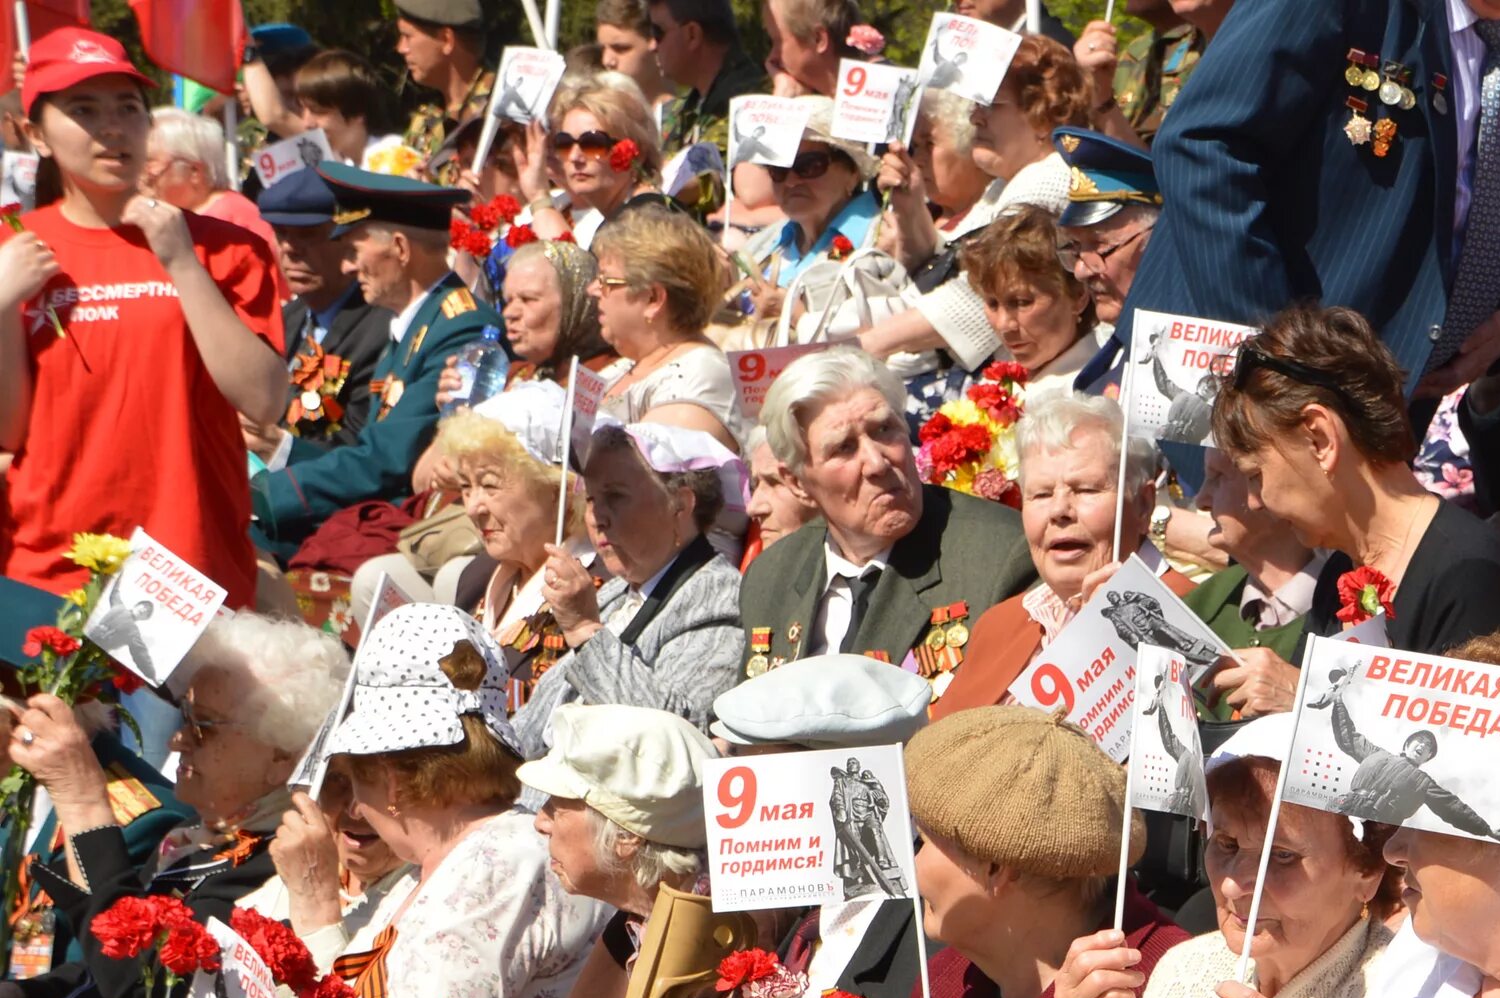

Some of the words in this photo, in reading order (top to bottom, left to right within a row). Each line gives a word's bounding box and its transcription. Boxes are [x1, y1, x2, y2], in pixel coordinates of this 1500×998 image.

[843, 66, 867, 97] 9
[260, 152, 276, 180] 9
[1169, 321, 1252, 350] ВЕЛИКА
[738, 353, 766, 382] 9
[140, 546, 217, 606] ВЕЛИКАЯ
[134, 572, 205, 627] ПОБЕДА
[1030, 662, 1075, 722] 9
[1076, 646, 1116, 693] мая
[1080, 678, 1125, 731] омним
[1125, 664, 1137, 681] и
[1090, 689, 1136, 745] ордимс
[1108, 729, 1132, 755] ПАРА
[715, 766, 757, 829] 9
[760, 802, 814, 822] мая
[719, 836, 801, 856] Помним
[808, 835, 821, 849] и
[721, 851, 824, 877] гордимся!
[740, 882, 834, 898] ПАРАМОНОВЪ
